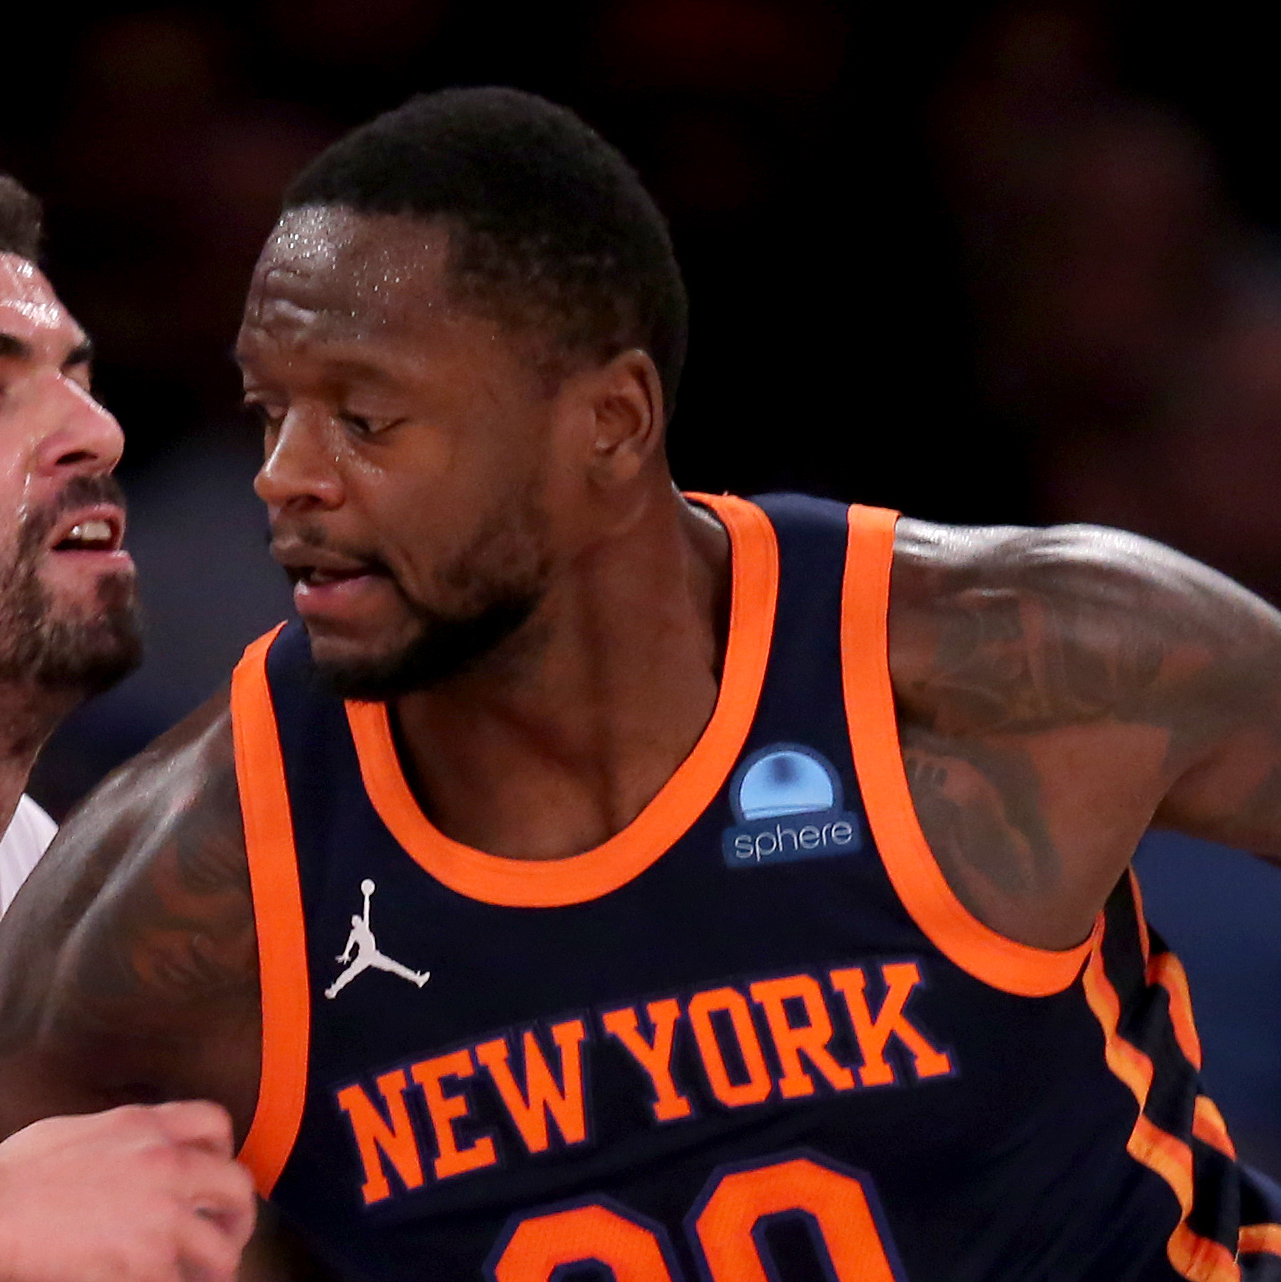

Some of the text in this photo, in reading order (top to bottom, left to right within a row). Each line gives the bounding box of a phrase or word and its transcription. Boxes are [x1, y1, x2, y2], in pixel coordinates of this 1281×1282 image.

[734, 820, 853, 862] sphere
[335, 961, 954, 1206] NEW YORK
